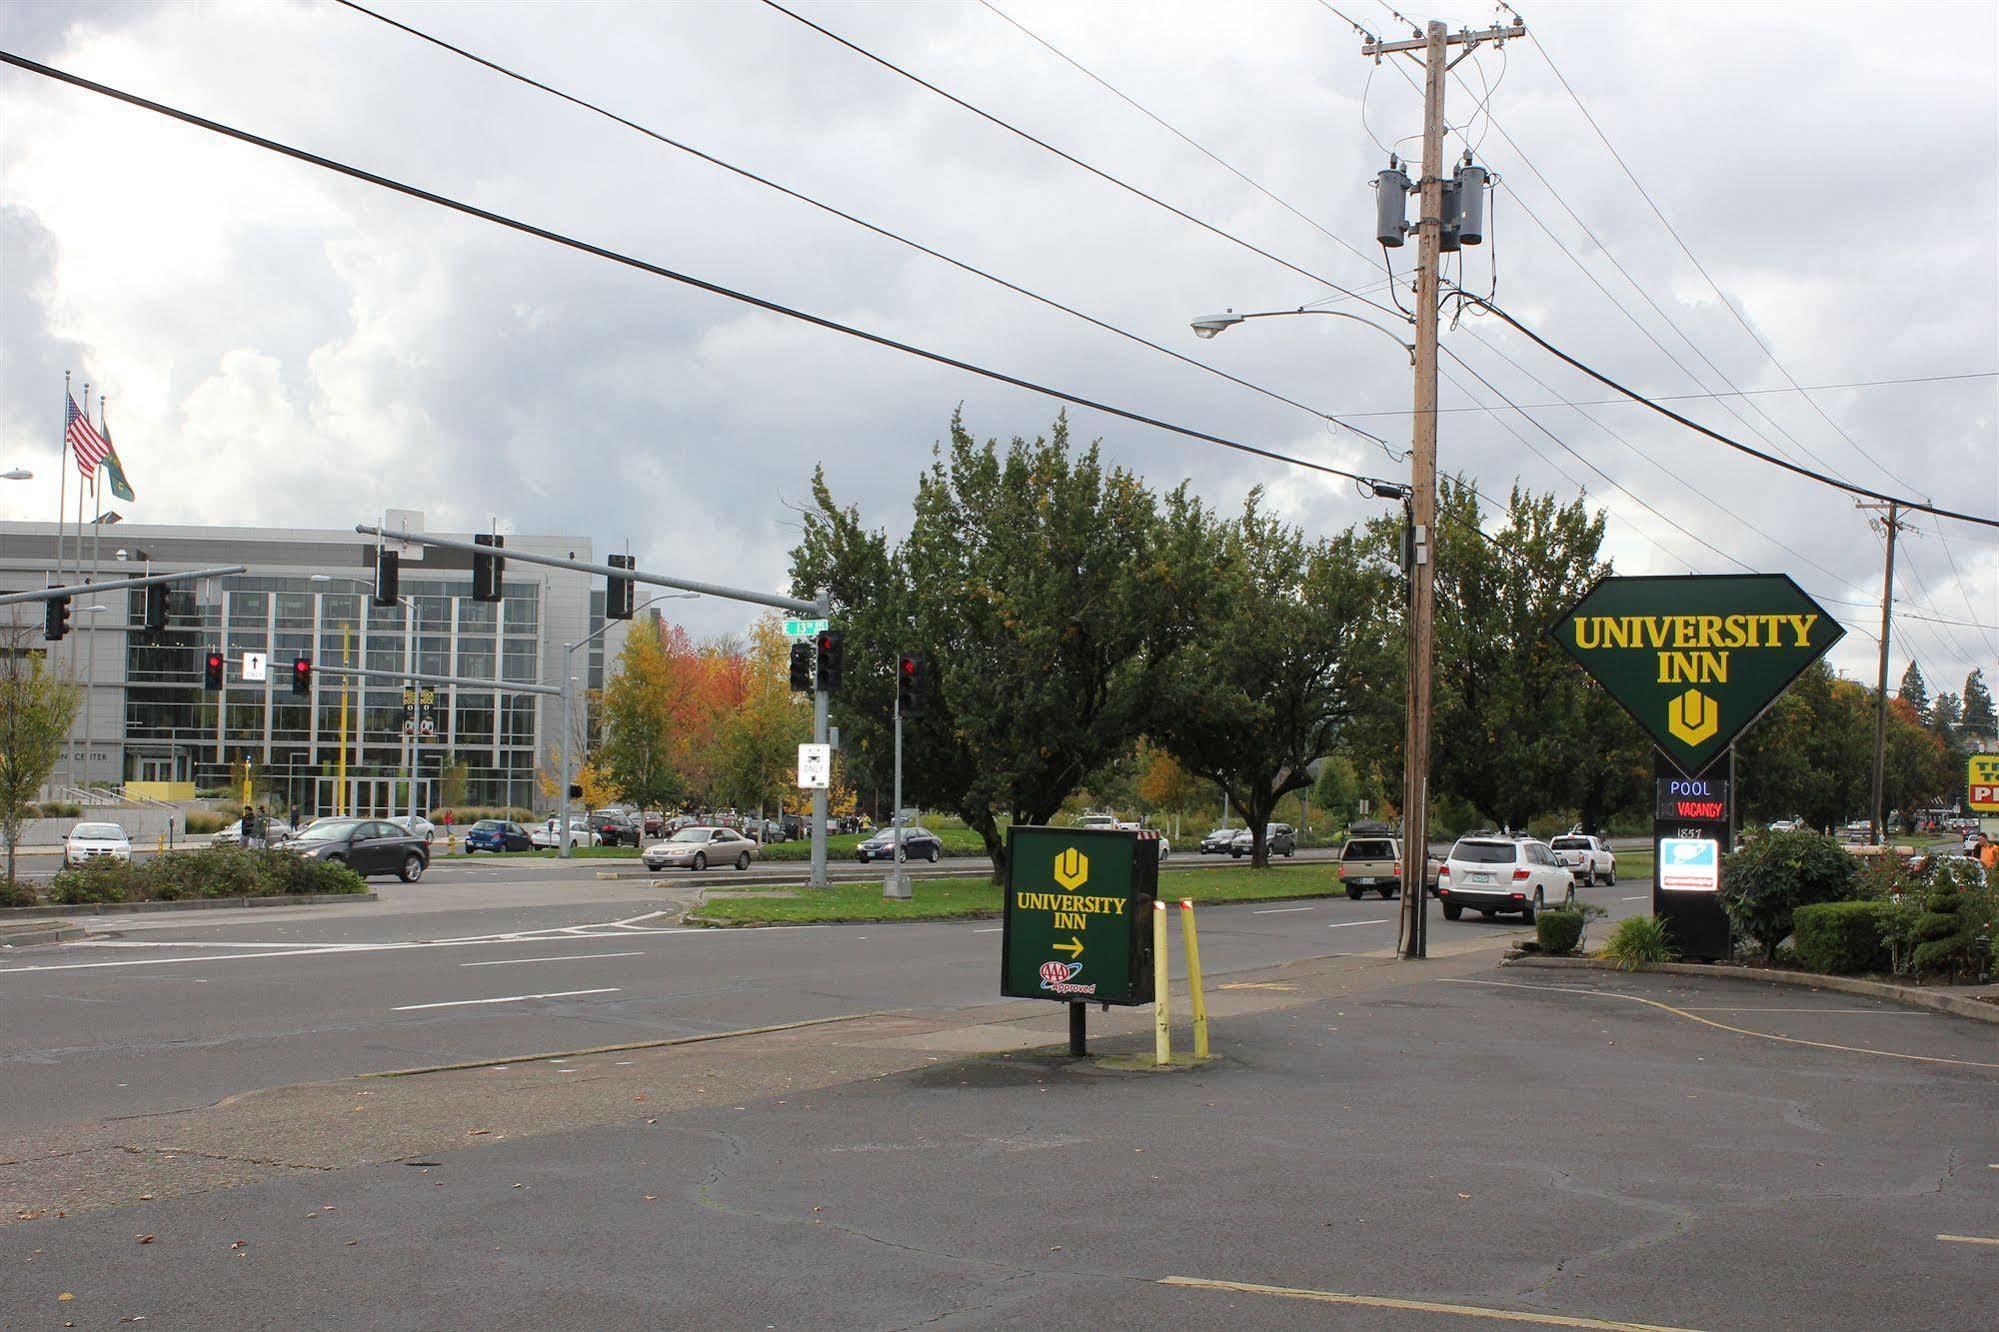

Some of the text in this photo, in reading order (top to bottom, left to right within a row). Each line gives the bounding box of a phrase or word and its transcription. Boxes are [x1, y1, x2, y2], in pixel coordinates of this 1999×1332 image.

[1573, 614, 1818, 649] UNIVERSITY
[1657, 651, 1729, 683] INN
[803, 763, 824, 774] ONLY
[1670, 781, 1710, 796] POOL
[1678, 802, 1722, 818] VACANCY
[1677, 828, 1702, 839] 1857
[1017, 892, 1126, 914] UNIVERSITY
[1054, 912, 1087, 930] INN
[1041, 962, 1068, 982] AAA
[1051, 982, 1096, 994] Approved
